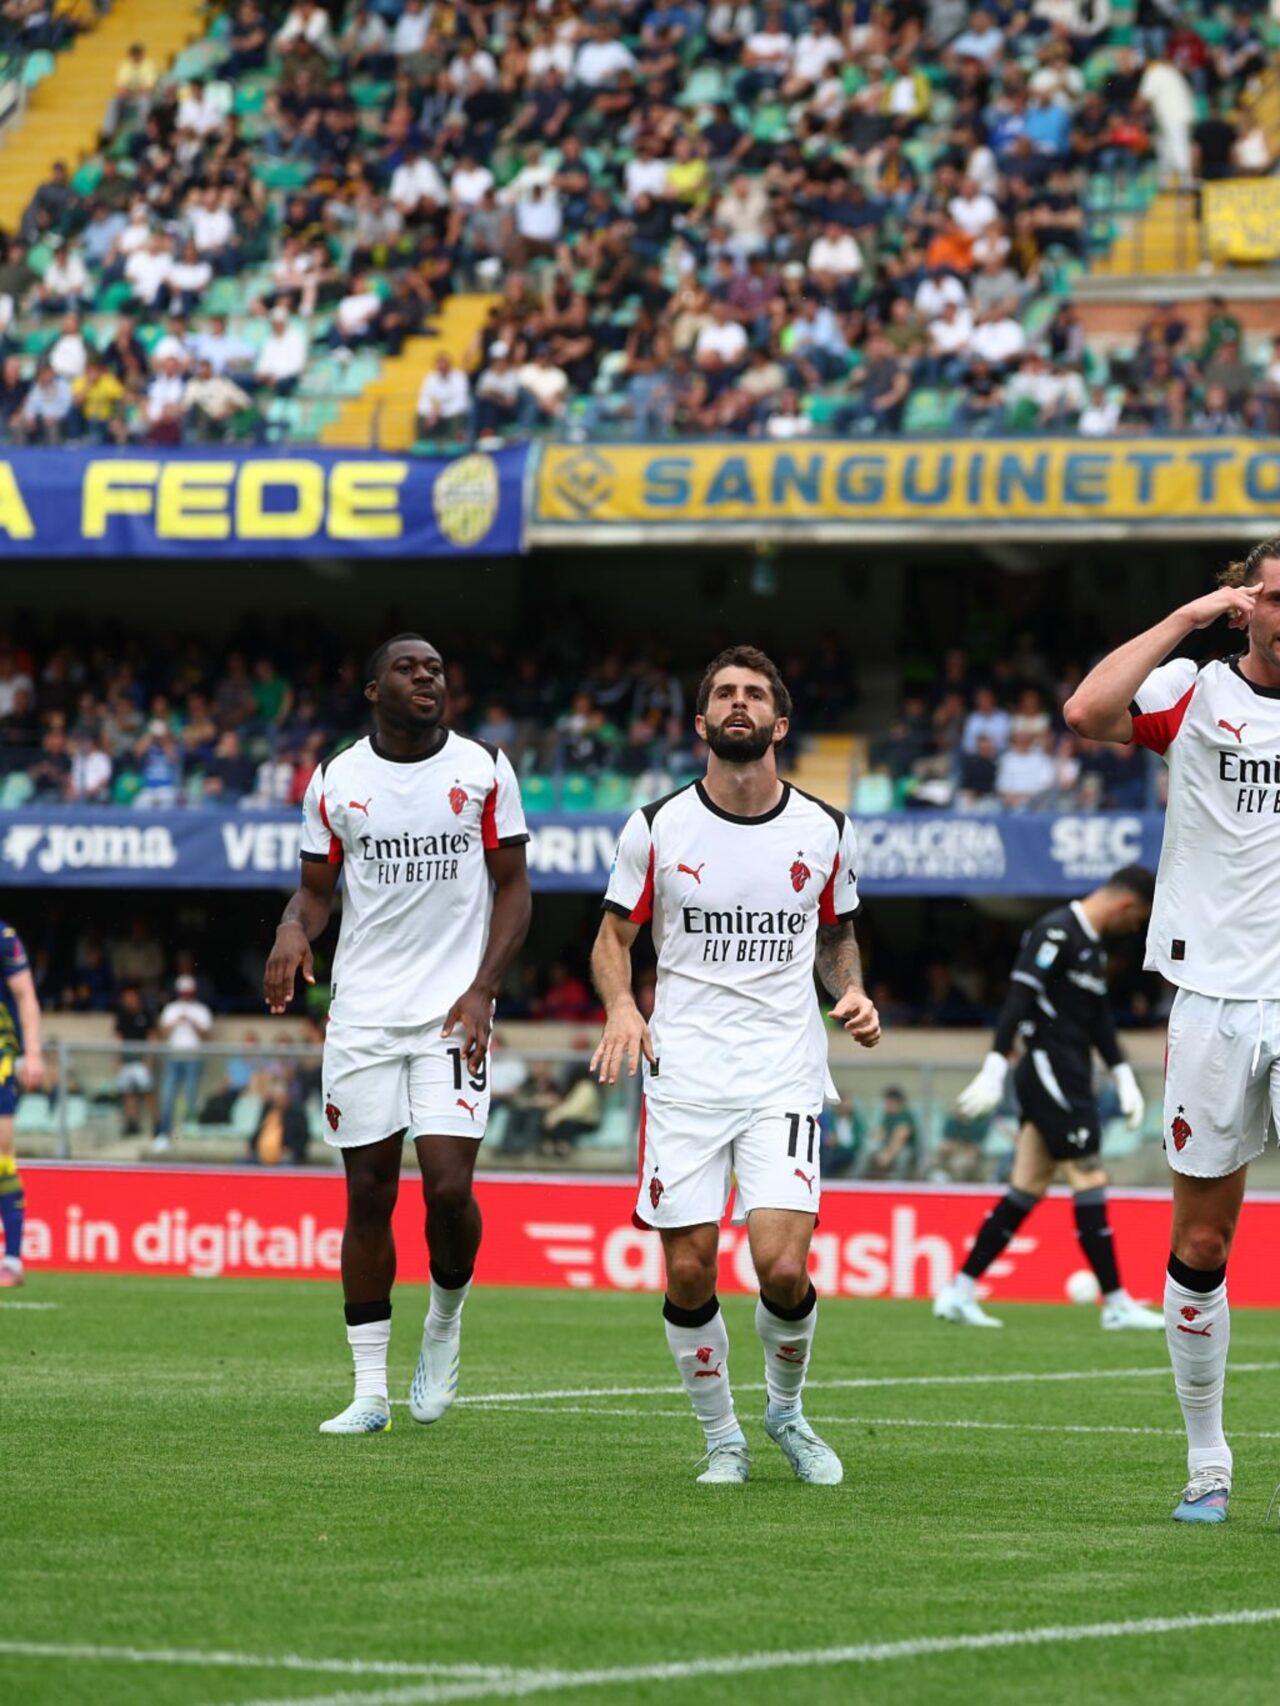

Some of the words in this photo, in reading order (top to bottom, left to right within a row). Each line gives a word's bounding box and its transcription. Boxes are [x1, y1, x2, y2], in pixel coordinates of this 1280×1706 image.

[81, 459, 409, 538] FEDE
[1236, 788, 1268, 813] FLY
[360, 831, 470, 861] Emirates
[1050, 816, 1143, 861] SEC
[378, 863, 400, 885] FLY
[406, 859, 459, 883] BETTER
[703, 939, 731, 962] FLY
[736, 939, 794, 962] BETTER
[446, 1047, 487, 1093] 19
[784, 1112, 816, 1162] 11
[67, 1205, 119, 1264] in
[132, 1208, 344, 1277] digitale
